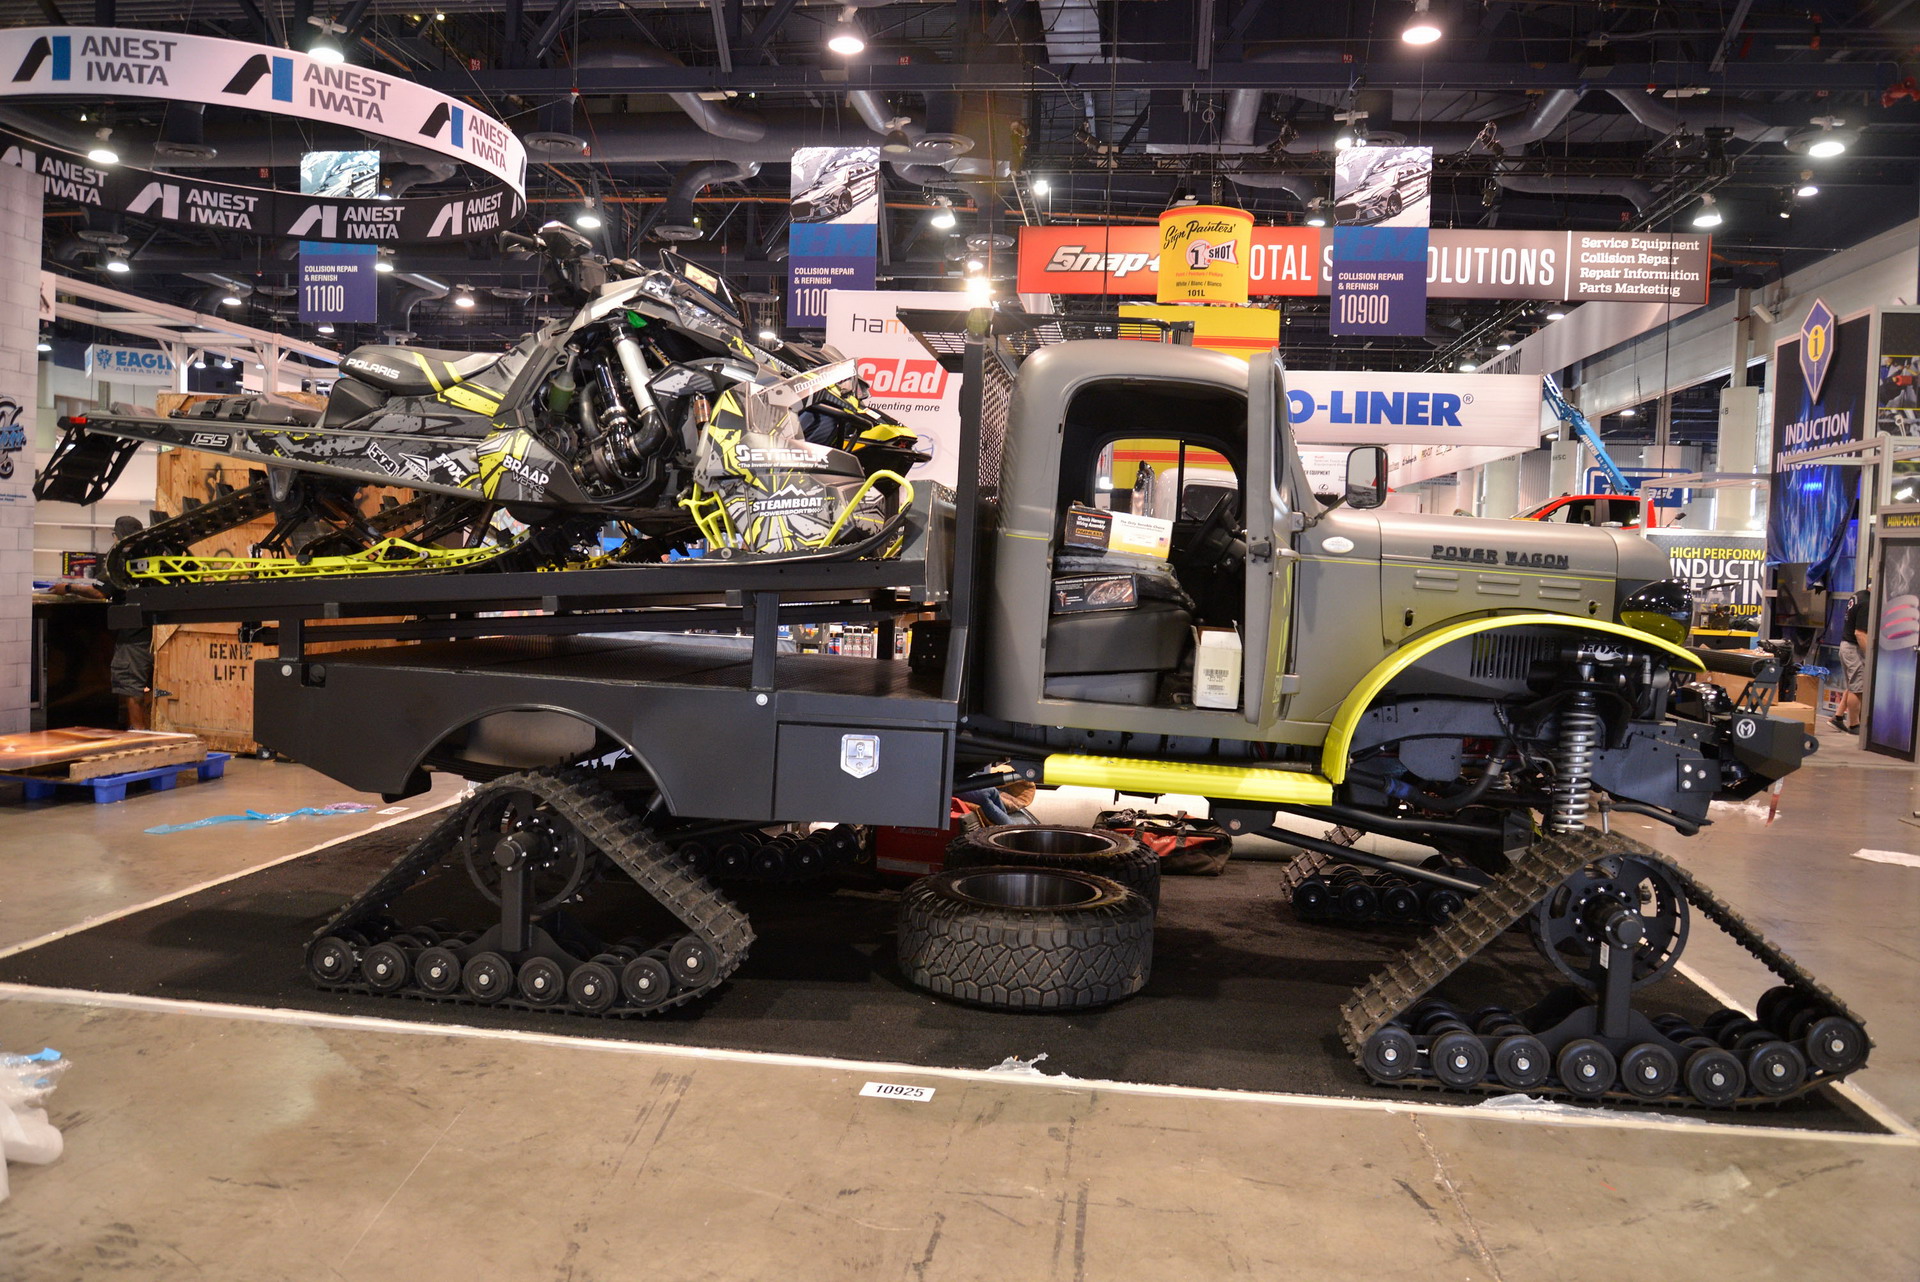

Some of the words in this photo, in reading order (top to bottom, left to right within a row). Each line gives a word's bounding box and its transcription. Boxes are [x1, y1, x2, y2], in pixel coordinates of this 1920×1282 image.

[81, 36, 177, 61] ANEST
[87, 61, 169, 86] IWATA
[303, 63, 391, 100] ANEST
[310, 87, 384, 123] IWATA
[468, 115, 509, 152] ANEST
[472, 137, 507, 172] IWATA
[41, 156, 109, 188] ANEST
[44, 177, 102, 206] IWATA
[186, 188, 259, 212] ANEST
[343, 206, 405, 222] ANEST
[465, 191, 503, 215] ANEST
[190, 206, 252, 230] IWATA
[467, 212, 500, 233] IWATA
[347, 223, 399, 239] IWATA
[1163, 225, 1186, 250] Sign
[1209, 245, 1231, 259] SHOT
[1581, 237, 1628, 249] Service
[1631, 238, 1700, 251] Equipment
[1581, 252, 1635, 264] Collision
[304, 265, 336, 274] COLLISION
[337, 265, 358, 273] REPAIR
[304, 274, 310, 282] &
[311, 274, 338, 282] REFINISH
[794, 267, 829, 275] COLLISION
[831, 268, 855, 276] REPAIR
[1339, 272, 1376, 281] COLLISION
[1378, 273, 1404, 281] REPAIR
[1580, 268, 1621, 281] Repair
[1624, 268, 1699, 281] Information
[801, 277, 832, 285] REFINISH
[1579, 283, 1612, 294] Parts
[1615, 284, 1680, 297] Marketing
[305, 285, 344, 313] 11100
[1339, 294, 1389, 324] 10900
[346, 358, 400, 380] POLARIS
[858, 362, 938, 394] Colad
[868, 402, 912, 412] inventing
[191, 432, 229, 446] 155
[1785, 411, 1849, 445] INDUCTION
[502, 454, 549, 485] BRAAP
[513, 472, 545, 494] WERKS
[753, 497, 823, 512] STEAMBOAT
[1431, 545, 1498, 564] POWER
[1505, 551, 1569, 569] WAGON
[1670, 547, 1700, 558] HIGH
[1669, 558, 1764, 580] INDUCTI
[209, 643, 253, 661] GENIE
[214, 665, 248, 681] LIFT
[876, 1084, 924, 1098] 10925
